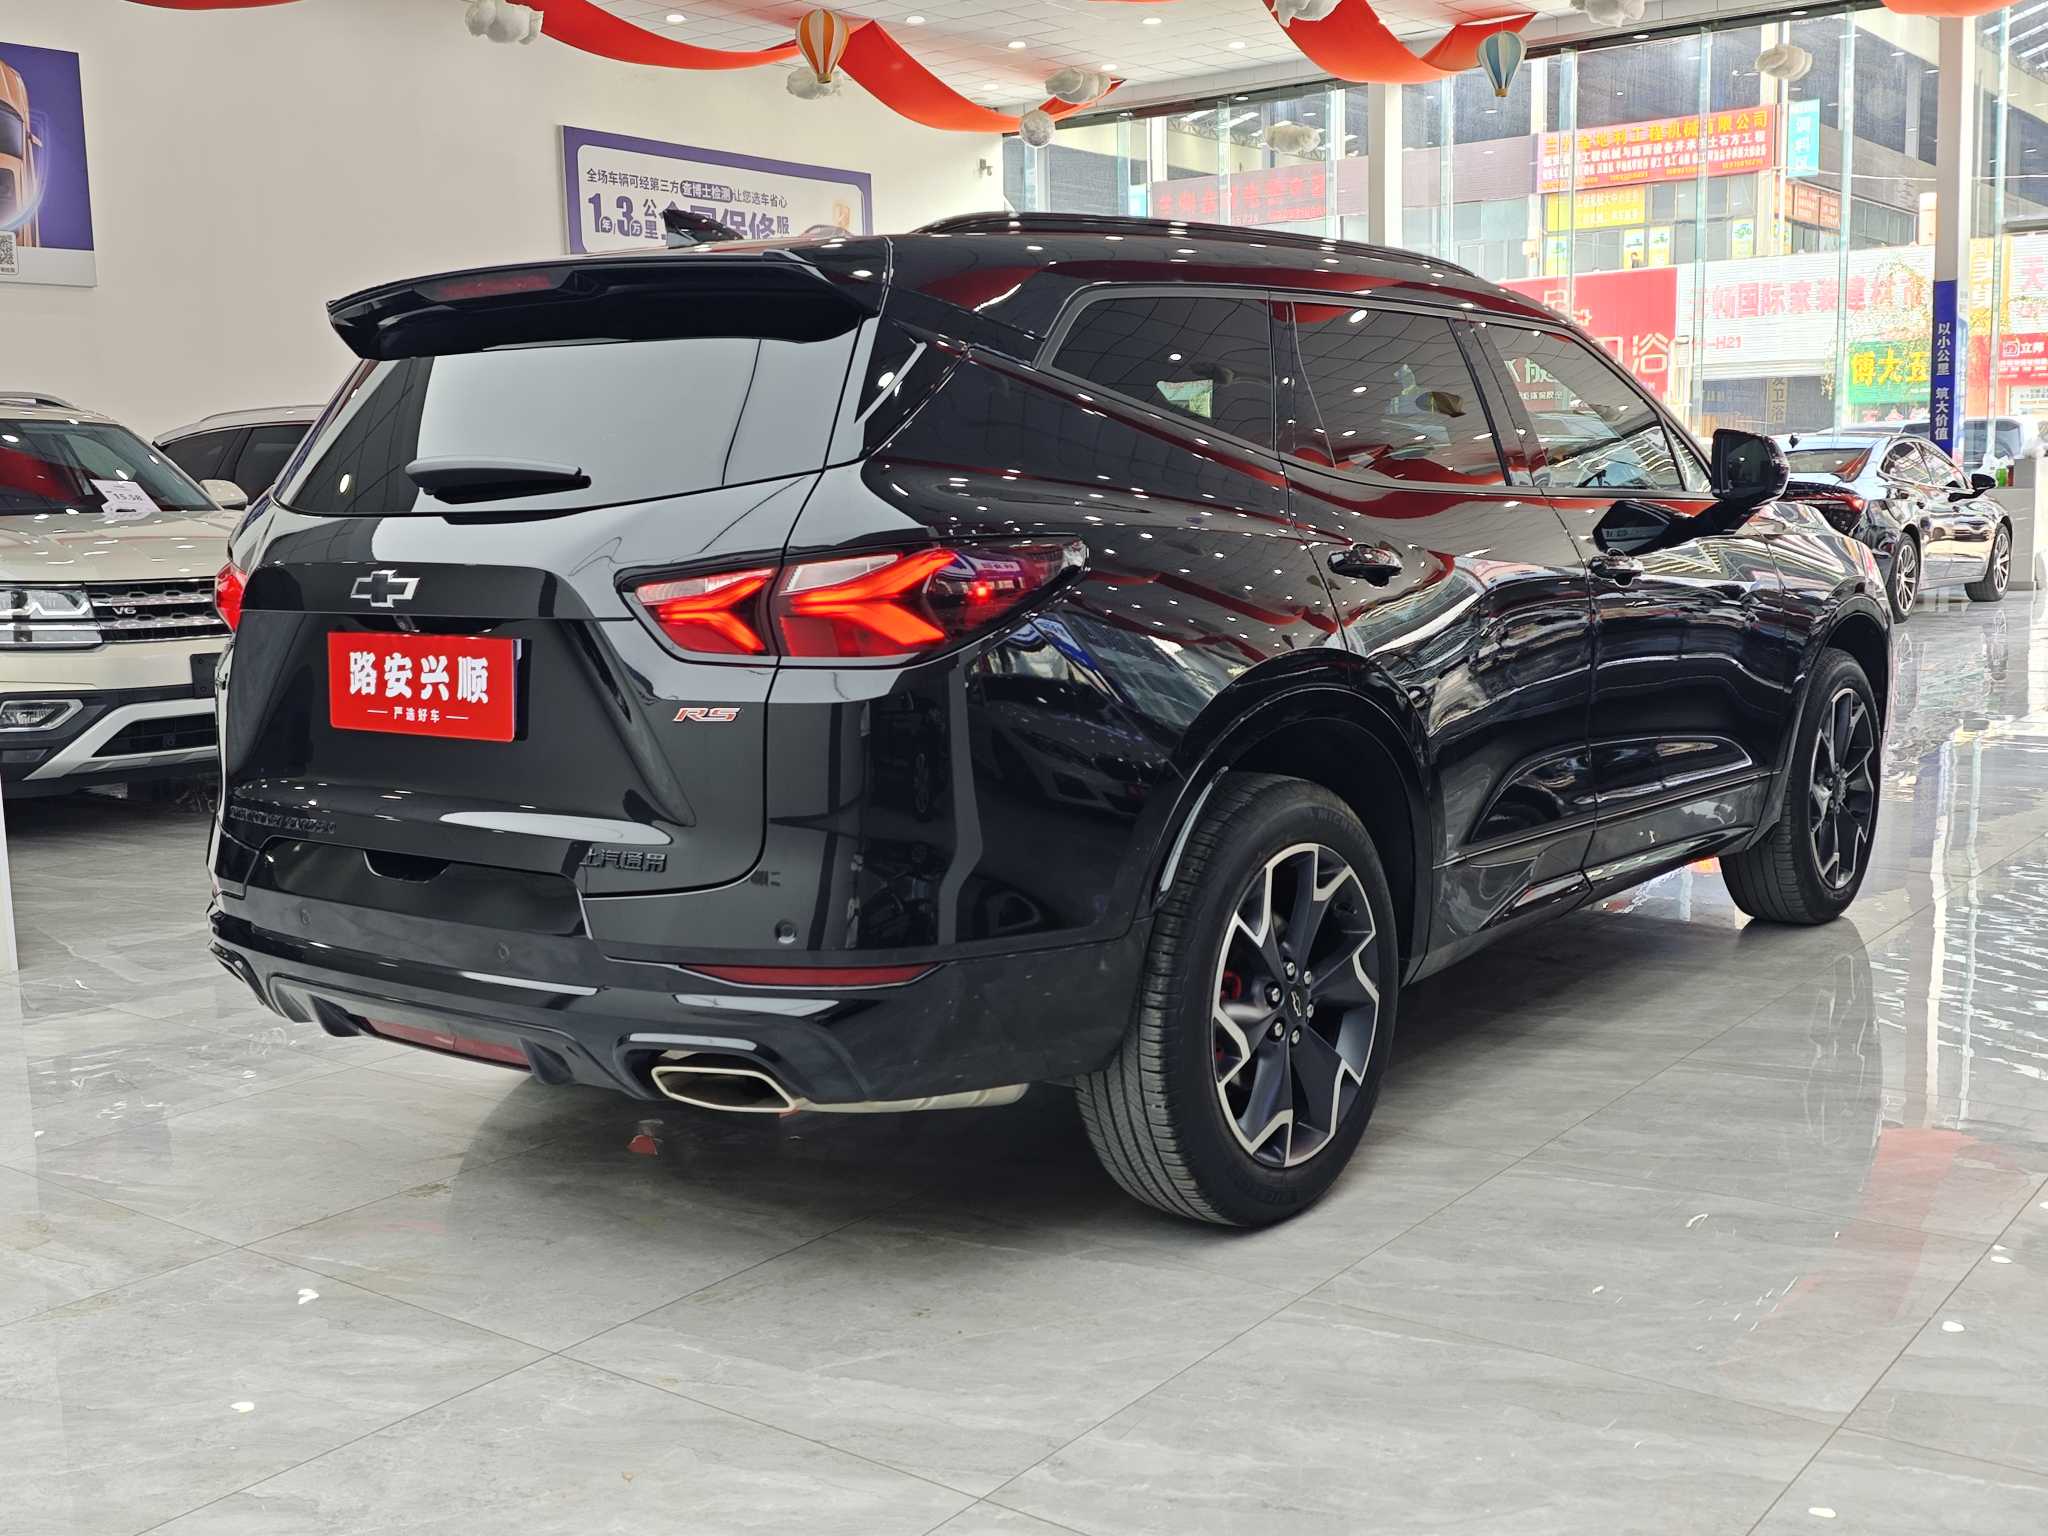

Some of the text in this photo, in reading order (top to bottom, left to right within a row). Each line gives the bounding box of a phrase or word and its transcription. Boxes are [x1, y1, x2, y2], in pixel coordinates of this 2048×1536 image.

[1934, 322, 1951, 440] 以小公里 筑大价值
[112, 606, 137, 616] V6
[349, 651, 489, 704] 路安兴顺
[393, 706, 441, 723] 严选好车
[672, 707, 741, 722] RS
[579, 847, 668, 873] 上汽通用
